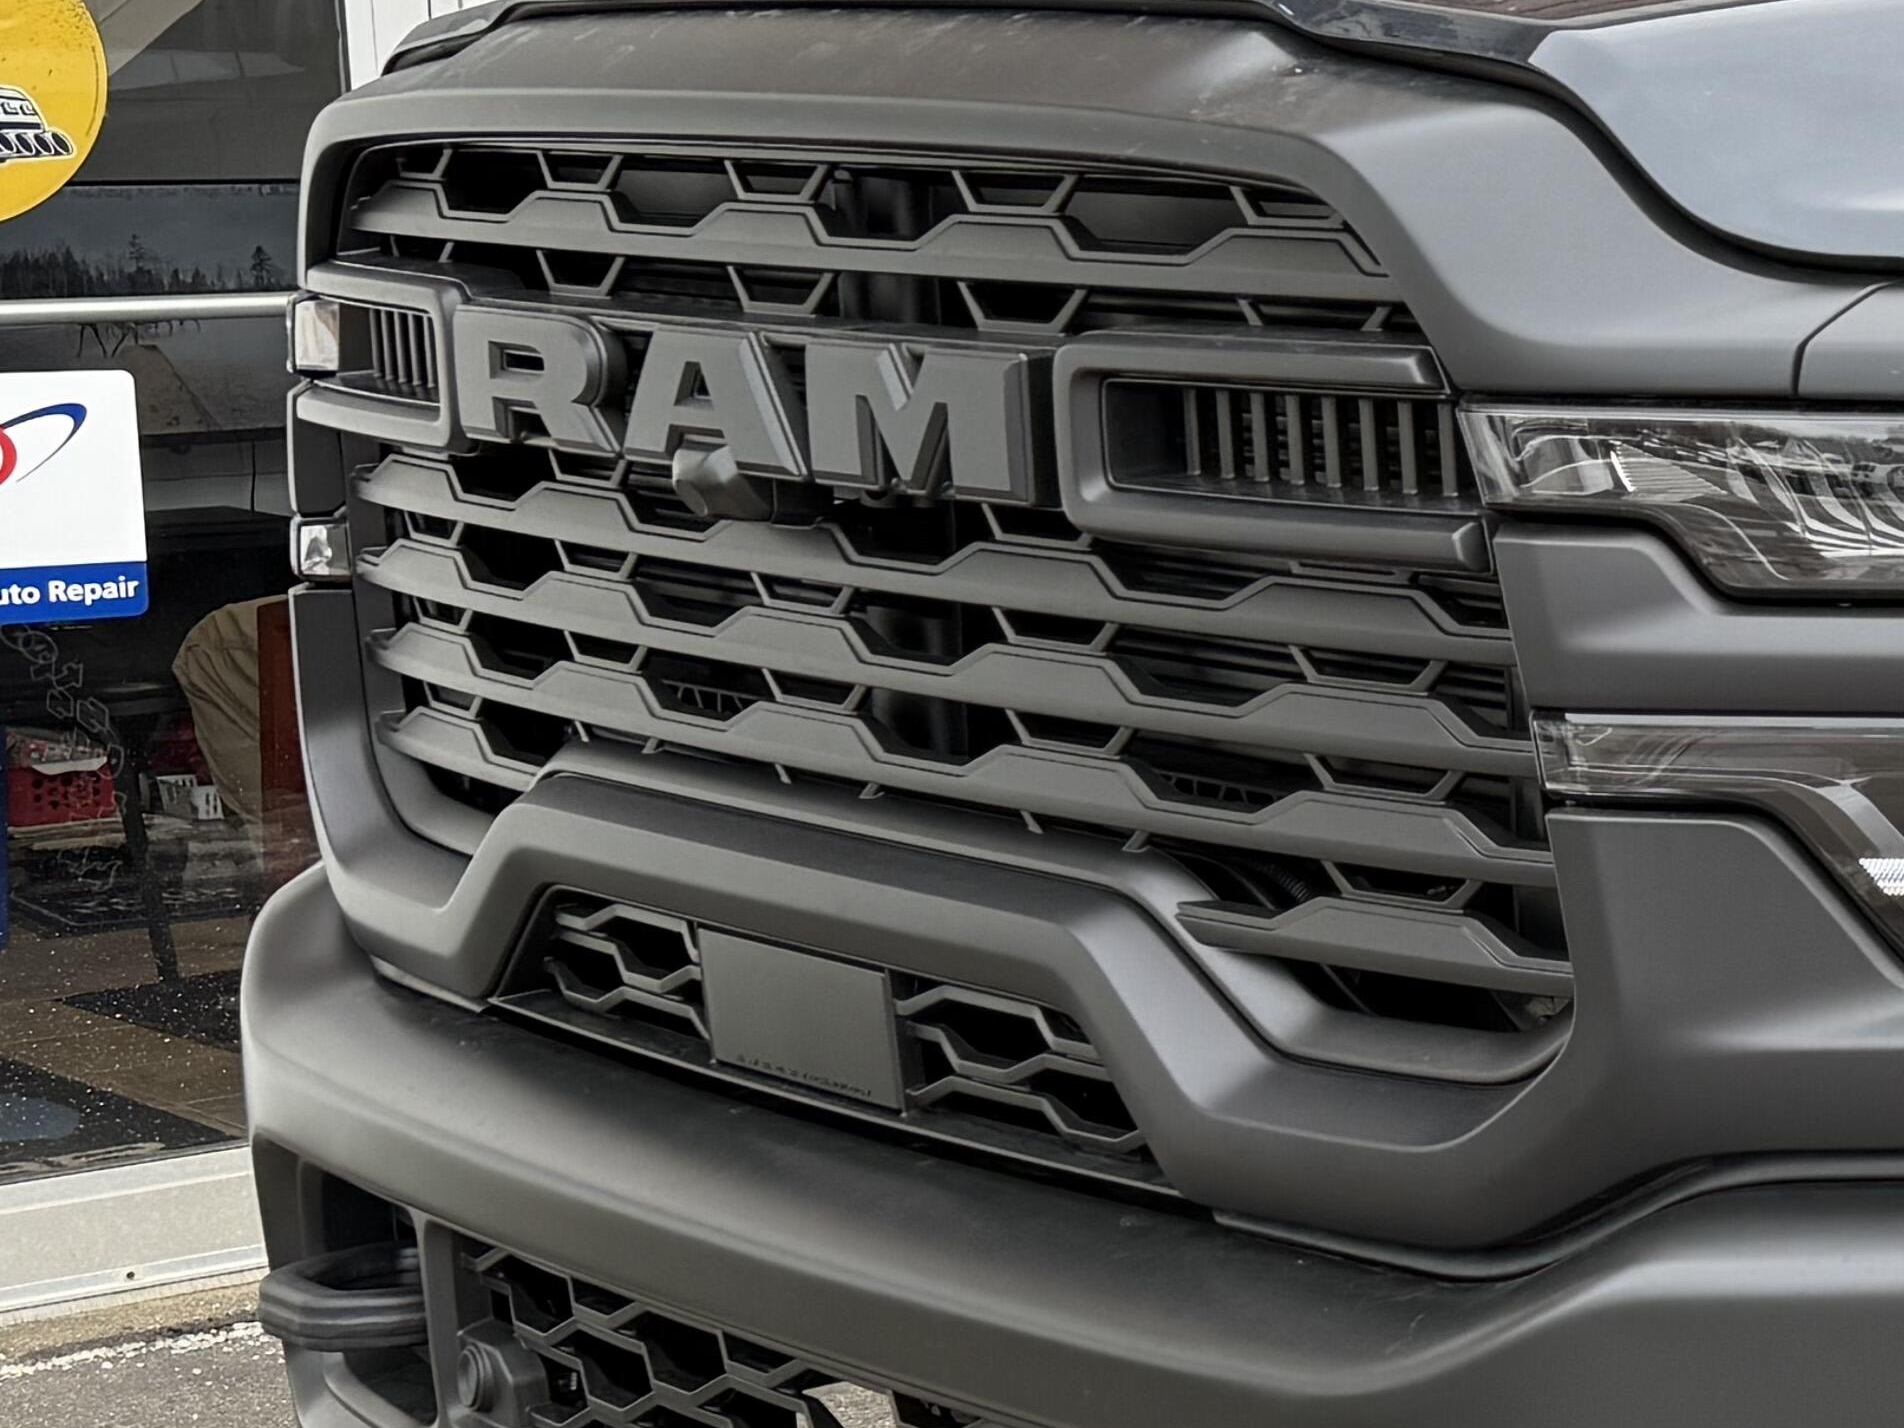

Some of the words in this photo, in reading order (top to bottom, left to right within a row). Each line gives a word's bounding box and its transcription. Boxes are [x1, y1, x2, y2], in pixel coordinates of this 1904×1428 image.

[452, 309, 1035, 507] RAM
[0, 583, 41, 606] uto
[48, 575, 140, 607] Repair
